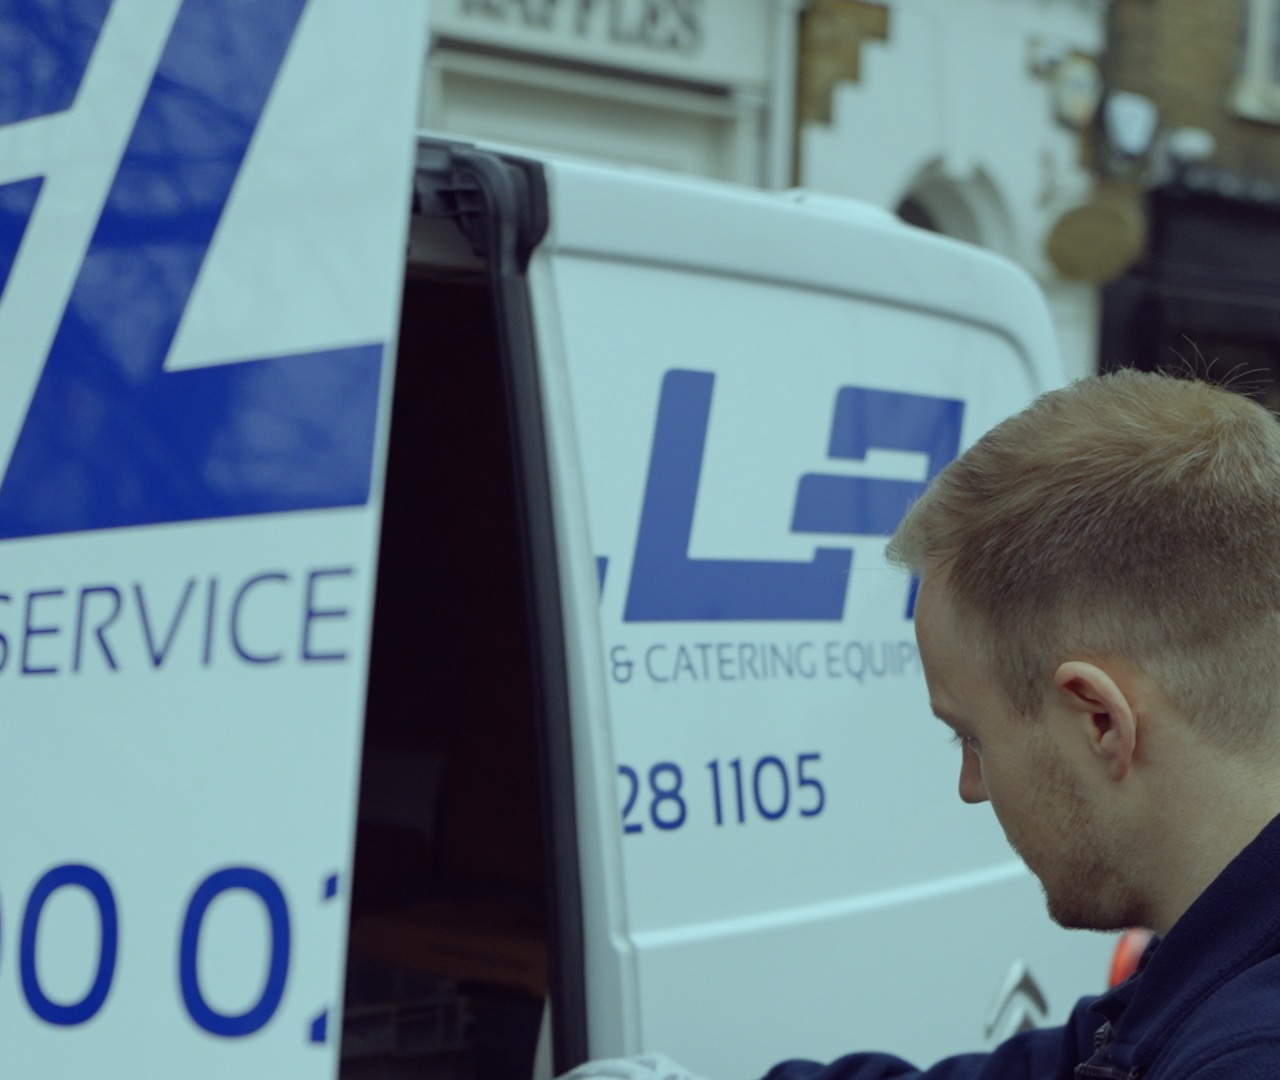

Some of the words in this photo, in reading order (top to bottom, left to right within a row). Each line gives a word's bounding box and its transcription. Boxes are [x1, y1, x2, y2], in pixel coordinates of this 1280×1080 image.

[609, 644, 634, 684] &
[644, 641, 818, 684] CATERING
[824, 641, 920, 685] EQUIP
[618, 761, 687, 835] 28
[705, 751, 826, 827] 1105
[177, 865, 339, 1044] 0
